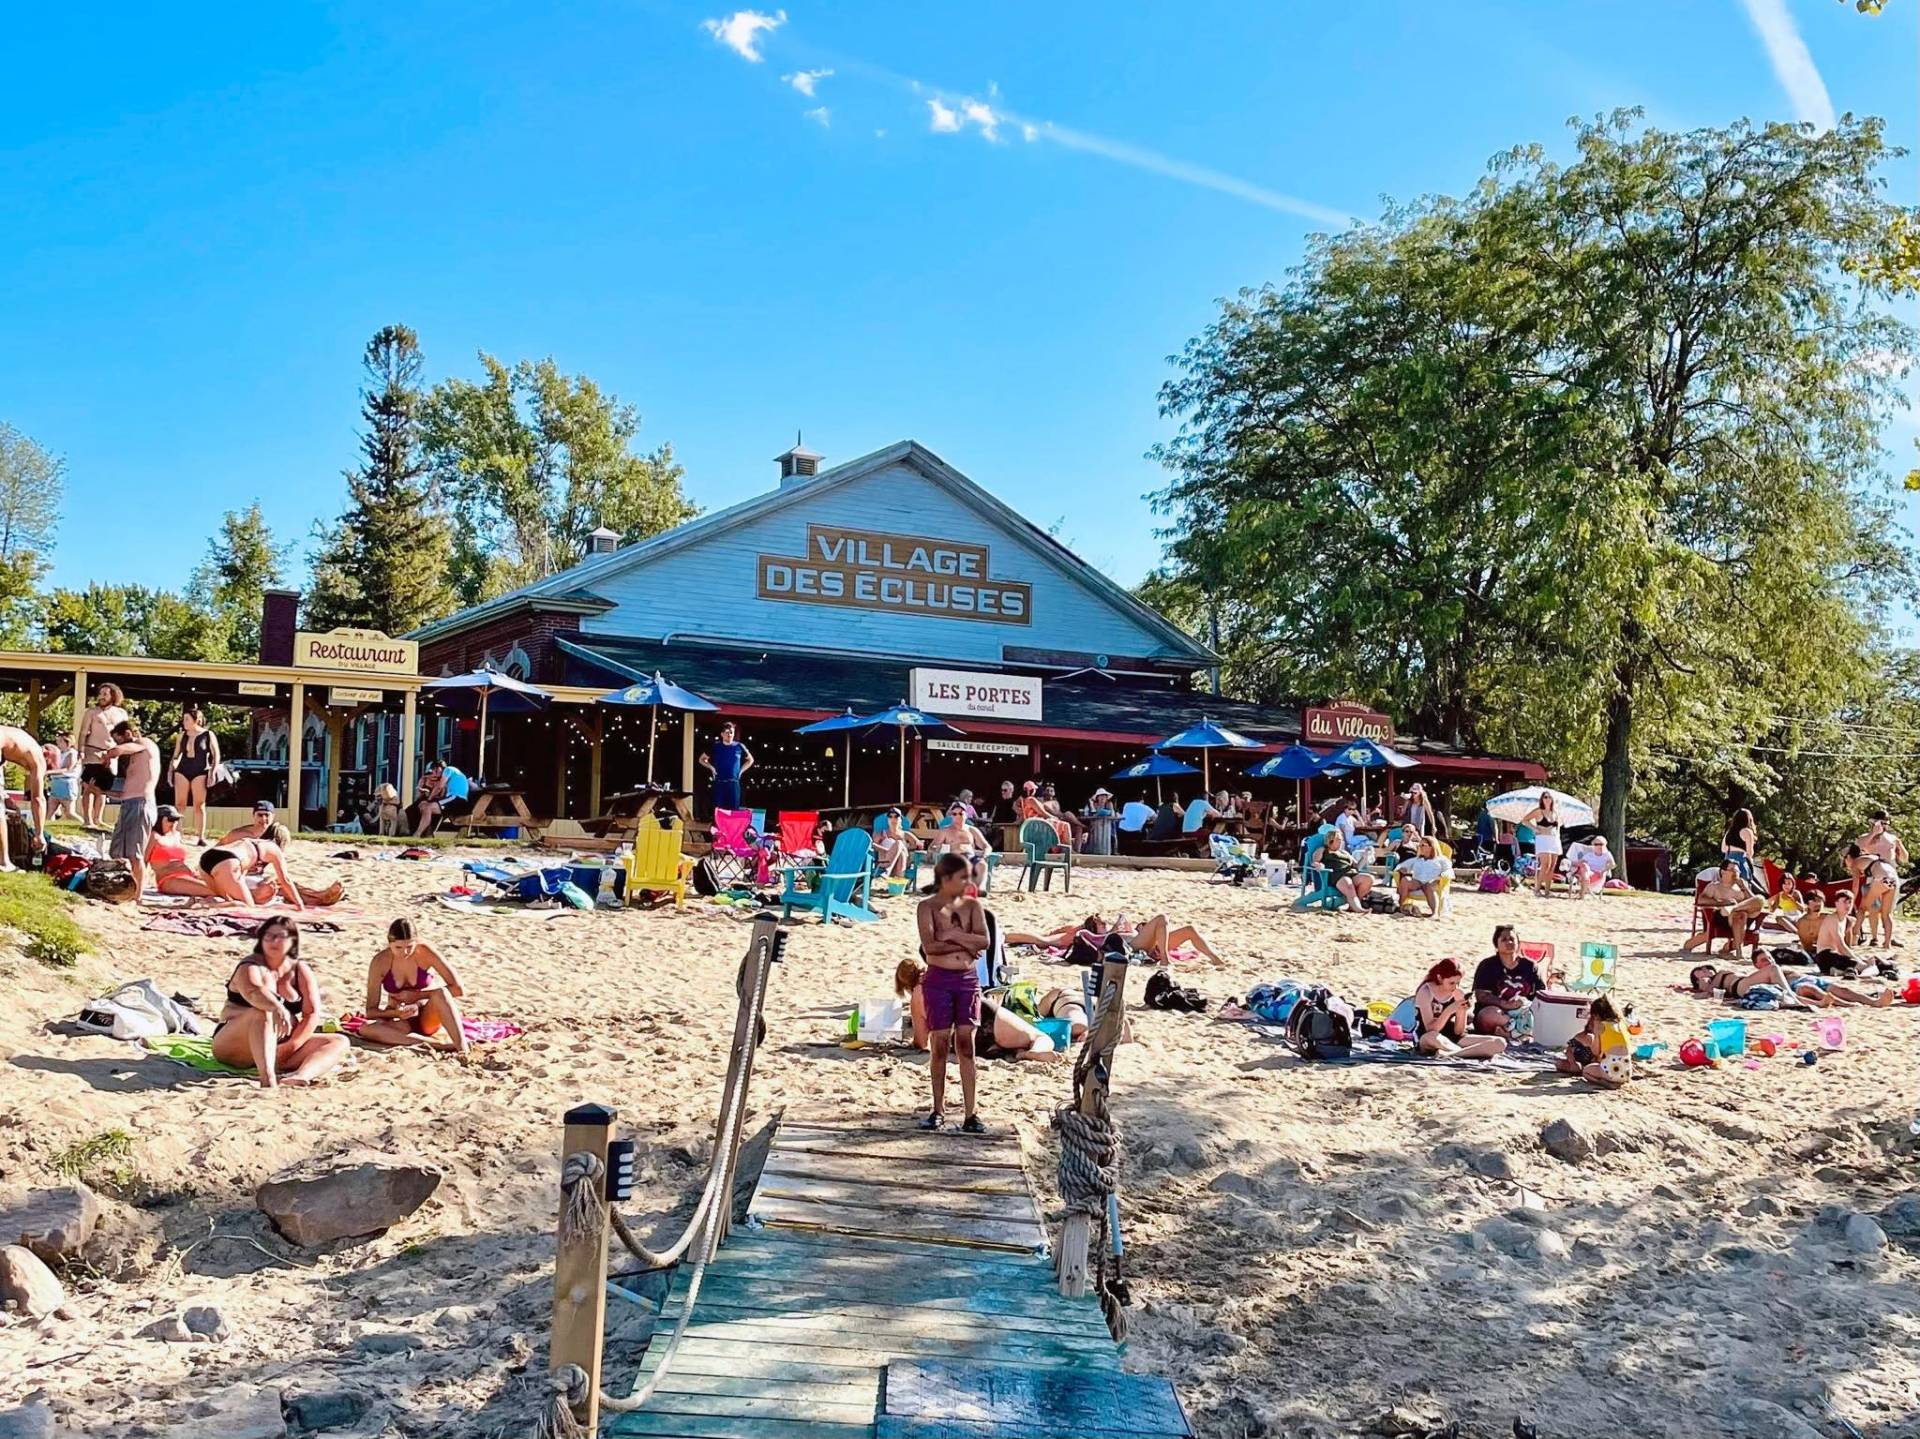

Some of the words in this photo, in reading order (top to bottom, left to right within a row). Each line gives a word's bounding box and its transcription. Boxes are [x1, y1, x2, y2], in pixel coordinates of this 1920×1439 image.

[816, 535, 981, 578] VILLAGE
[766, 564, 844, 597] DES
[854, 571, 1024, 616] ÉCLUSES
[310, 640, 407, 664] Restaurant
[928, 682, 960, 700] LES
[966, 685, 1031, 705] PORTES
[967, 703, 976, 711] du
[1330, 702, 1340, 710] LA
[1311, 713, 1332, 735] du
[1336, 717, 1390, 744] Village
[936, 741, 961, 749] SALLE
[976, 743, 1020, 753] RÉCEPTION
